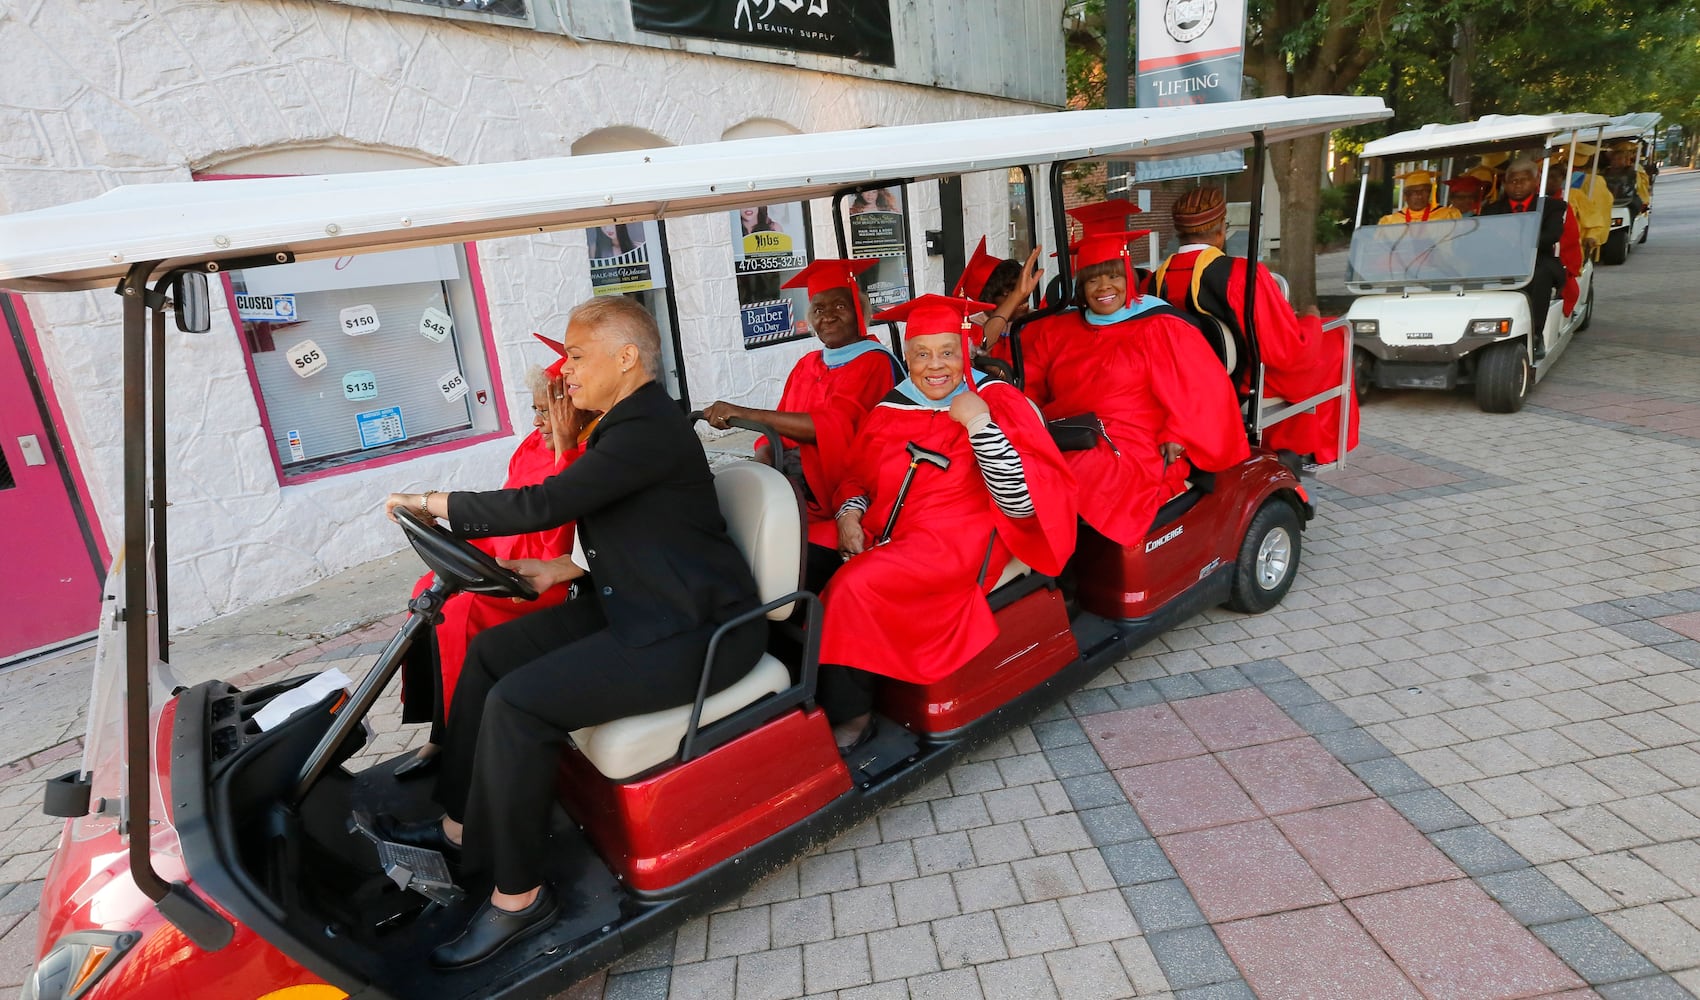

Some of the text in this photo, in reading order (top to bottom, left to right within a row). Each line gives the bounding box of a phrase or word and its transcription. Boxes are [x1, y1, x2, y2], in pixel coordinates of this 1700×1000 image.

[756, 22, 835, 41] BEAUTY SUPPLY
[739, 255, 803, 270] 470-355-3279
[236, 296, 273, 310] CLOSED
[345, 316, 374, 329] $150
[746, 307, 783, 325] Barber
[423, 319, 445, 335] $45
[753, 323, 780, 333] On Duty
[295, 350, 320, 368] $65
[346, 381, 375, 393] $135
[442, 376, 462, 393] $65
